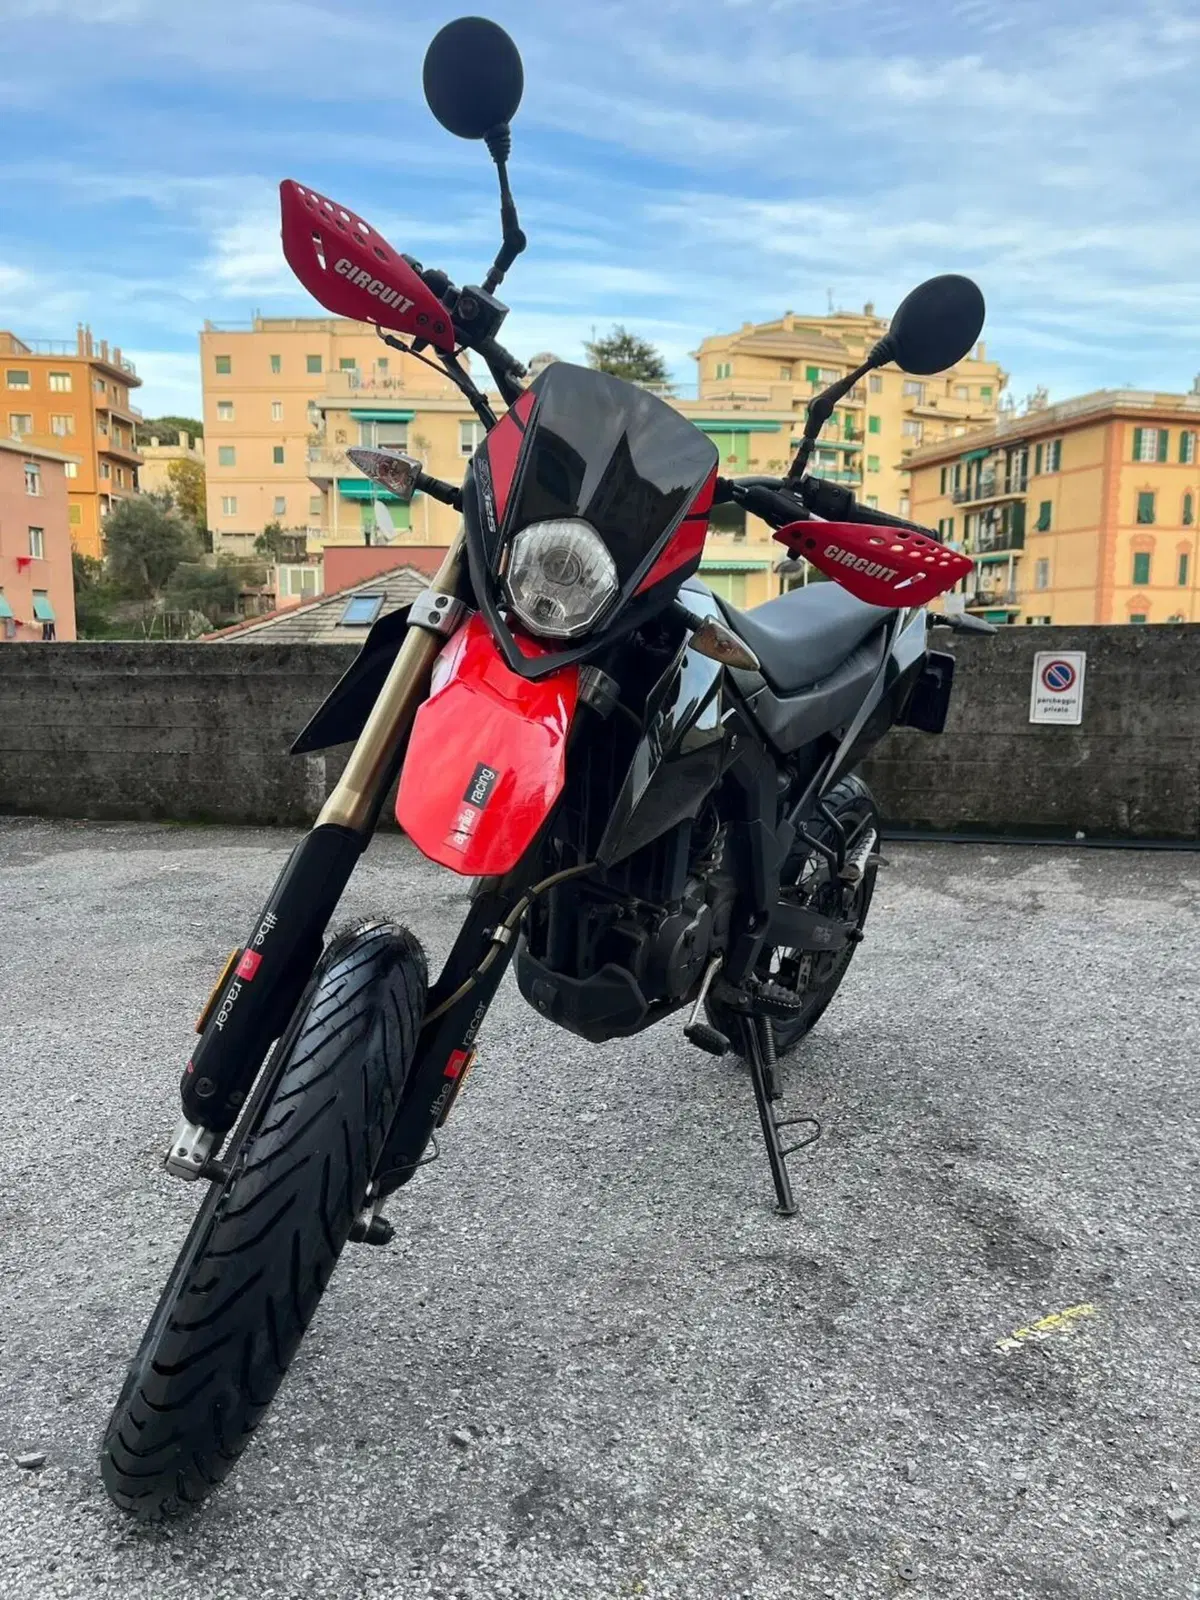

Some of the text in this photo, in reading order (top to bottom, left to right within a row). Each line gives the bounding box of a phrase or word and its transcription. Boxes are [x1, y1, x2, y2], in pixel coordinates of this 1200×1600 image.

[334, 258, 415, 313] CIRCUIT
[823, 545, 899, 582] CIRCUIT
[1037, 696, 1076, 705] parcheggio
[470, 768, 495, 804] racing
[254, 911, 278, 946] #be
[215, 982, 242, 1031] racer
[429, 1083, 451, 1118] #be
[462, 1001, 486, 1046] racer
